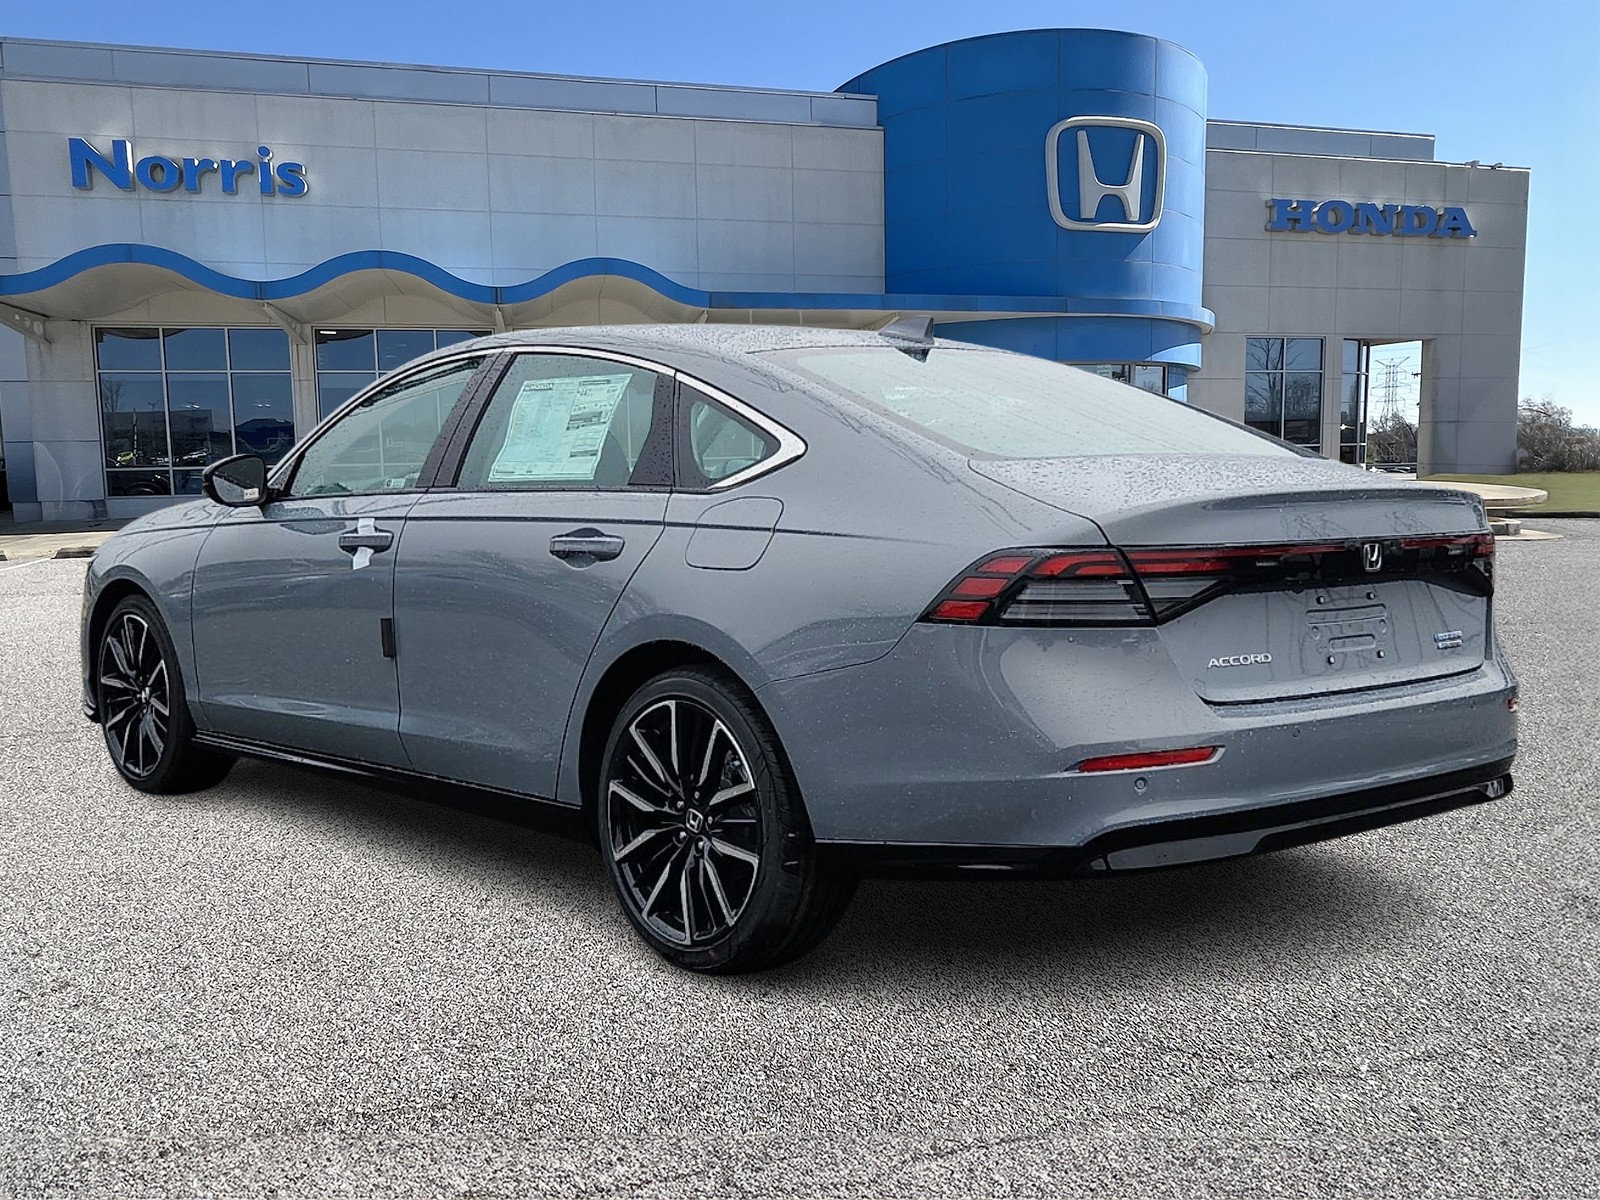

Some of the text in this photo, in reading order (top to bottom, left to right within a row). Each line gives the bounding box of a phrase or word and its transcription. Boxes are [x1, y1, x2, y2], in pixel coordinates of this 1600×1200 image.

[68, 137, 309, 197] Norris
[1266, 198, 1478, 239] HONDA
[1207, 653, 1272, 669] ACCORD
